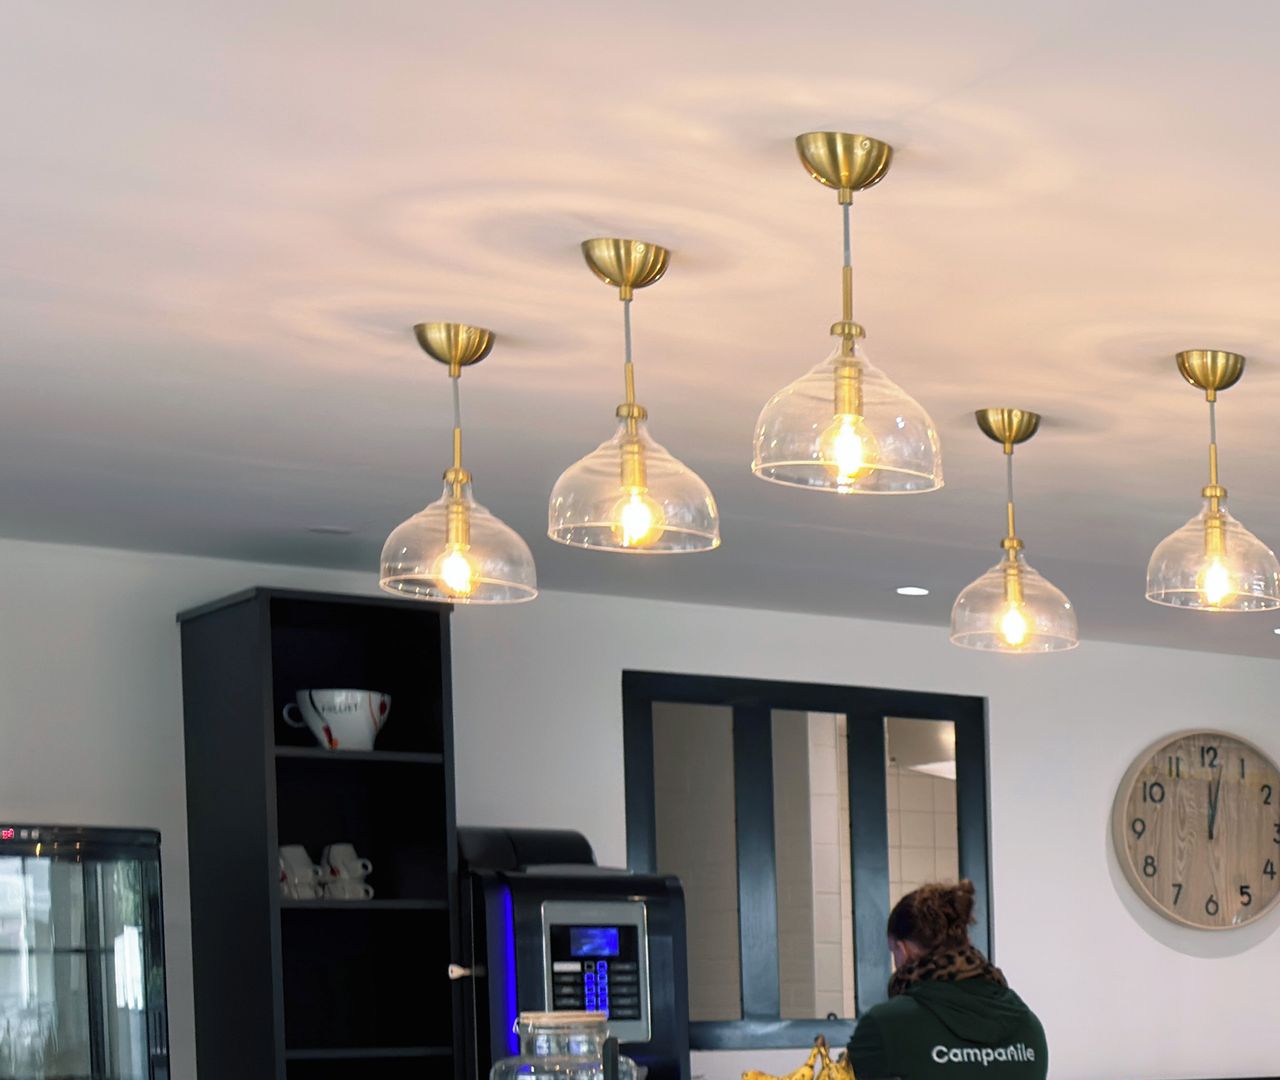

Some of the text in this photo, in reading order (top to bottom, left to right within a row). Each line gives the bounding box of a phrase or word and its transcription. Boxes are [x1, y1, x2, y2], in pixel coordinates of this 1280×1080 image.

[1168, 756, 1180, 778] 11
[1201, 746, 1218, 768] 12
[1239, 758, 1245, 779] 1
[1142, 782, 1165, 804] 10
[1260, 785, 1272, 806] 2
[1131, 818, 1146, 840] 9
[1143, 856, 1157, 877] 8
[1263, 858, 1277, 880] 4
[1171, 883, 1183, 906] 7
[1205, 894, 1219, 916] 6
[1239, 885, 1252, 906] 5
[931, 1043, 1036, 1067] Campanile
